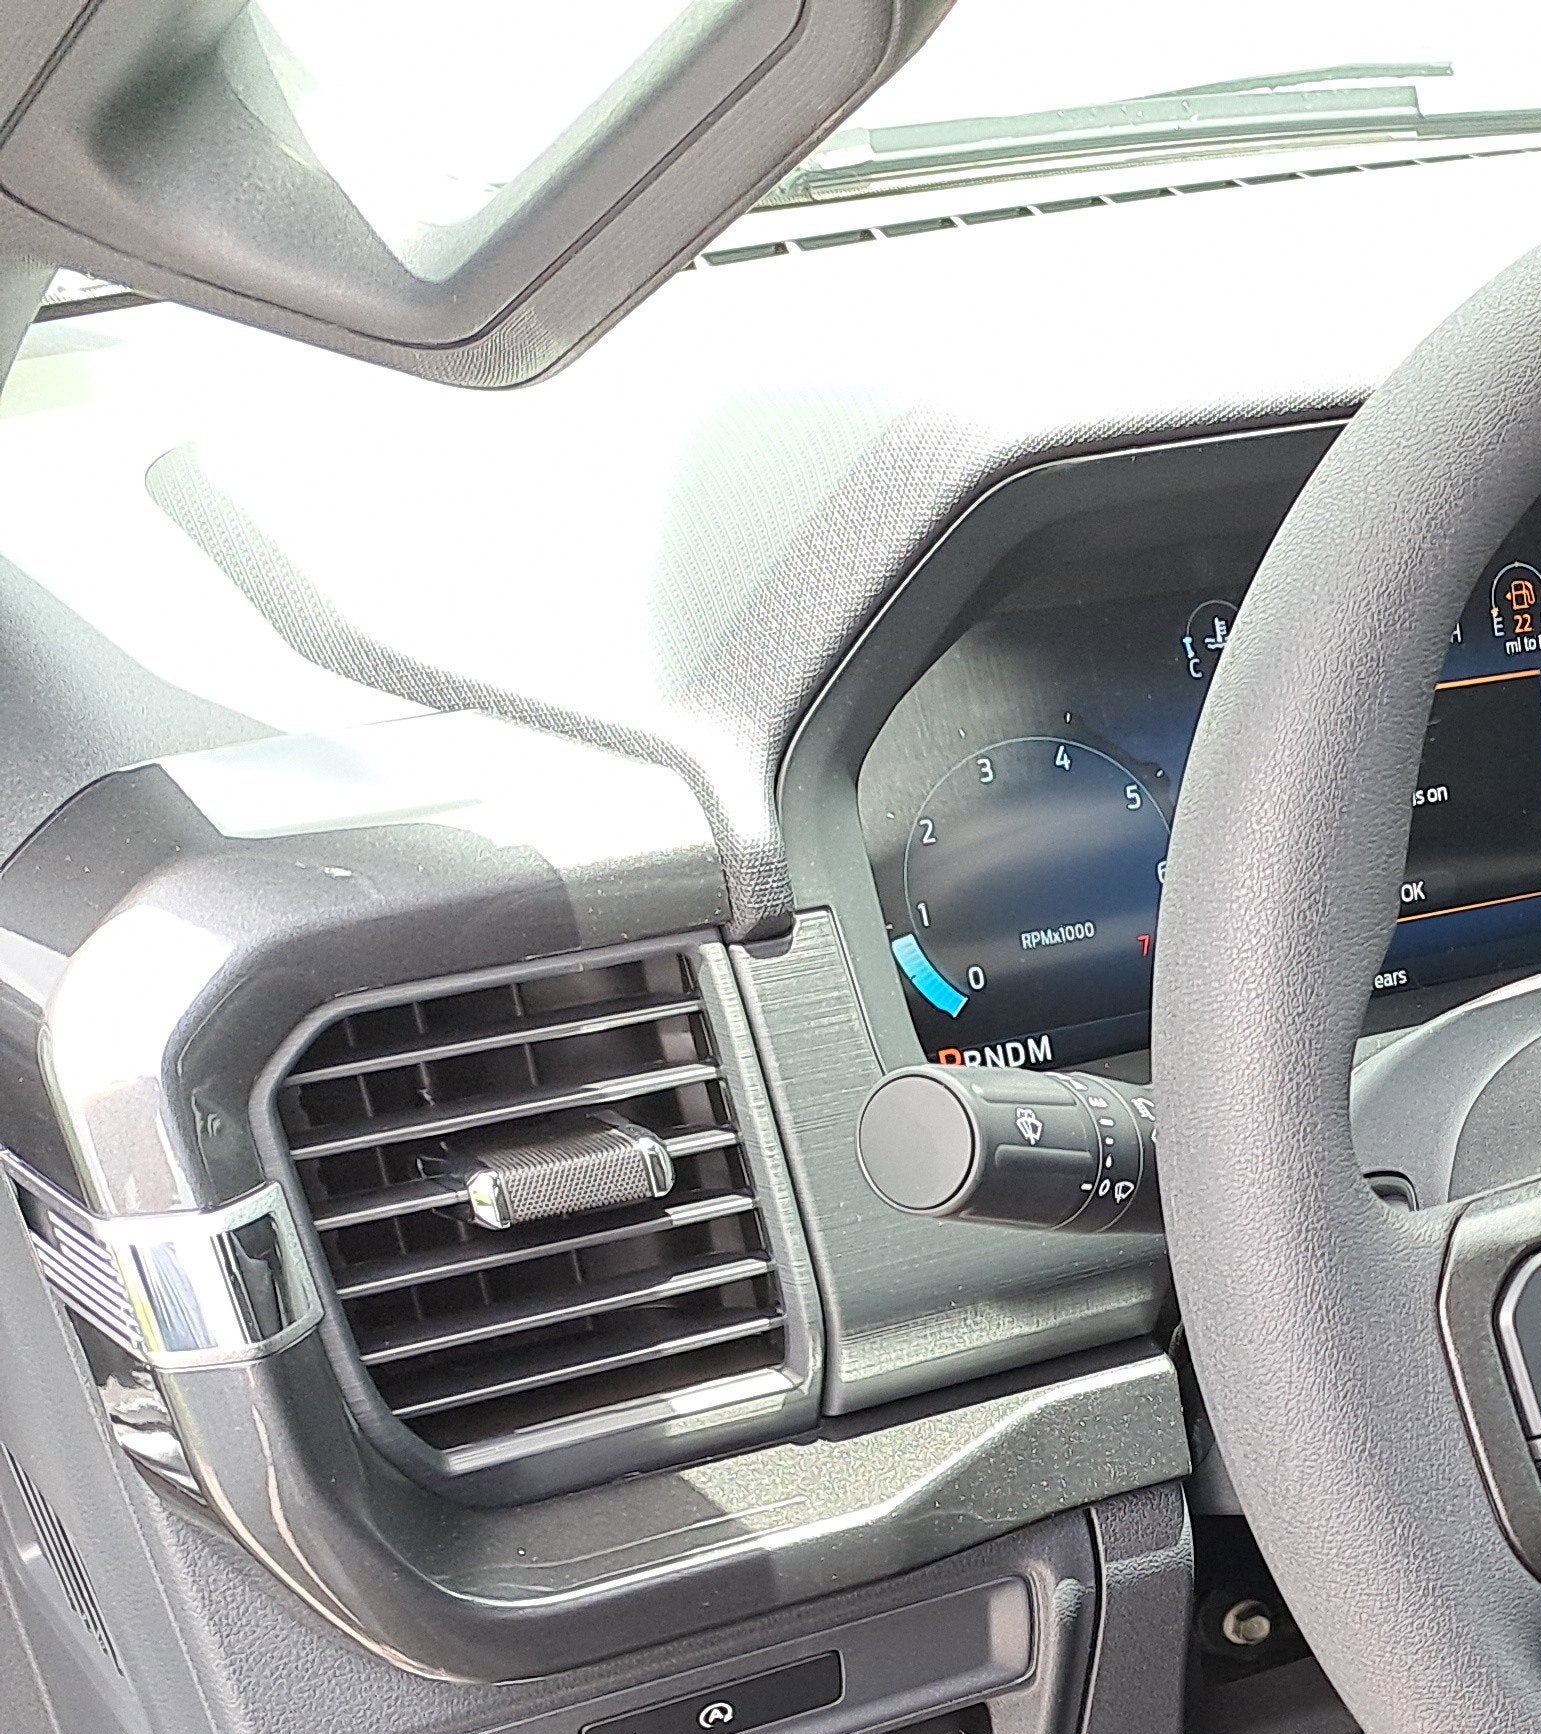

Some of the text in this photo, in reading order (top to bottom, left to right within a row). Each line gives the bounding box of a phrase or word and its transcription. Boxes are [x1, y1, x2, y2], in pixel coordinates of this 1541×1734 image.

[1493, 617, 1505, 637] E
[1513, 613, 1533, 634] 22
[1524, 636, 1537, 651] to
[1189, 658, 1203, 678] C
[1055, 745, 1071, 771] 4
[977, 758, 994, 783] 3
[1125, 784, 1142, 810] 5
[1427, 785, 1448, 803] on
[919, 819, 937, 844] 2
[1400, 880, 1425, 903] OK
[917, 902, 930, 927] 1
[1020, 921, 1096, 950] RPMx1000
[1138, 935, 1151, 957] 7
[967, 966, 985, 990] 0
